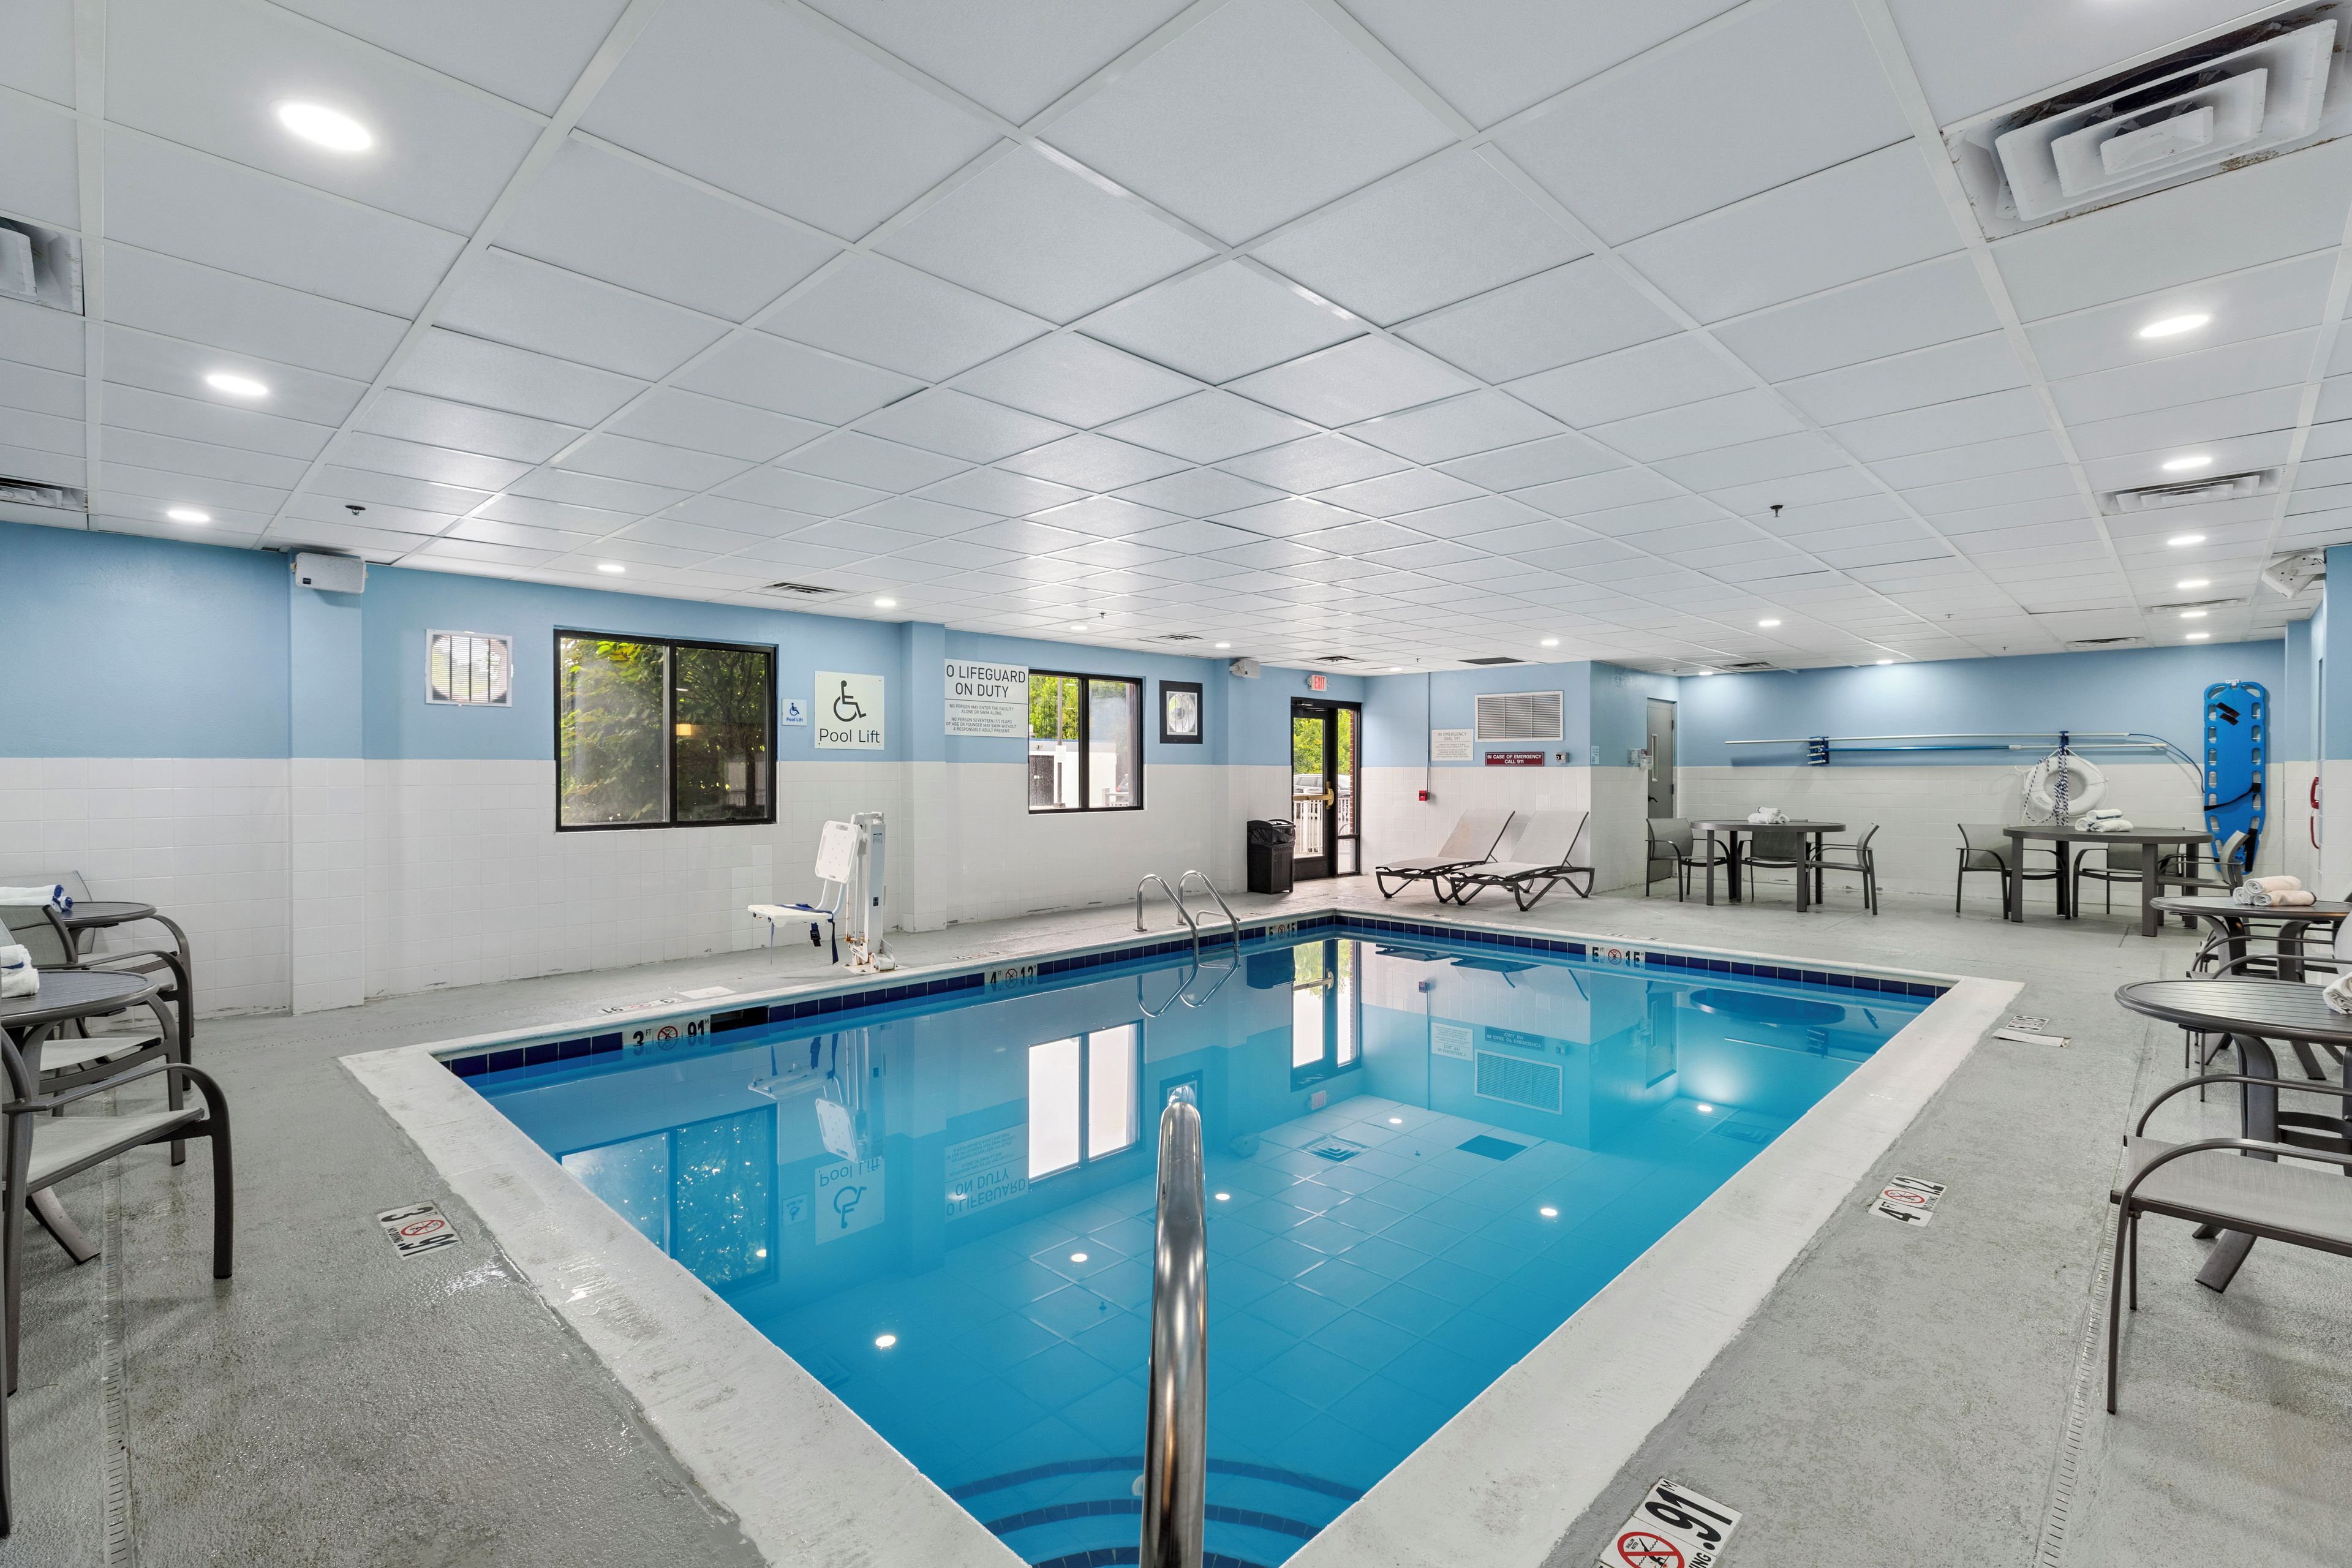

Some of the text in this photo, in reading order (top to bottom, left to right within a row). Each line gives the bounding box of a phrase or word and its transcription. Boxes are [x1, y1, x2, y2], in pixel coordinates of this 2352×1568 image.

[946, 665, 1026, 683] O LIFEGUARD
[956, 682, 1009, 698] ON DUTY
[1314, 676, 1325, 690] EXIT
[820, 728, 880, 743] Pool Lift
[1593, 946, 1599, 957] 5
[990, 971, 997, 984] 4
[381, 1206, 434, 1223] 3
[1879, 1201, 1921, 1223] 4 FT
[1645, 1480, 1733, 1550] .91 M
